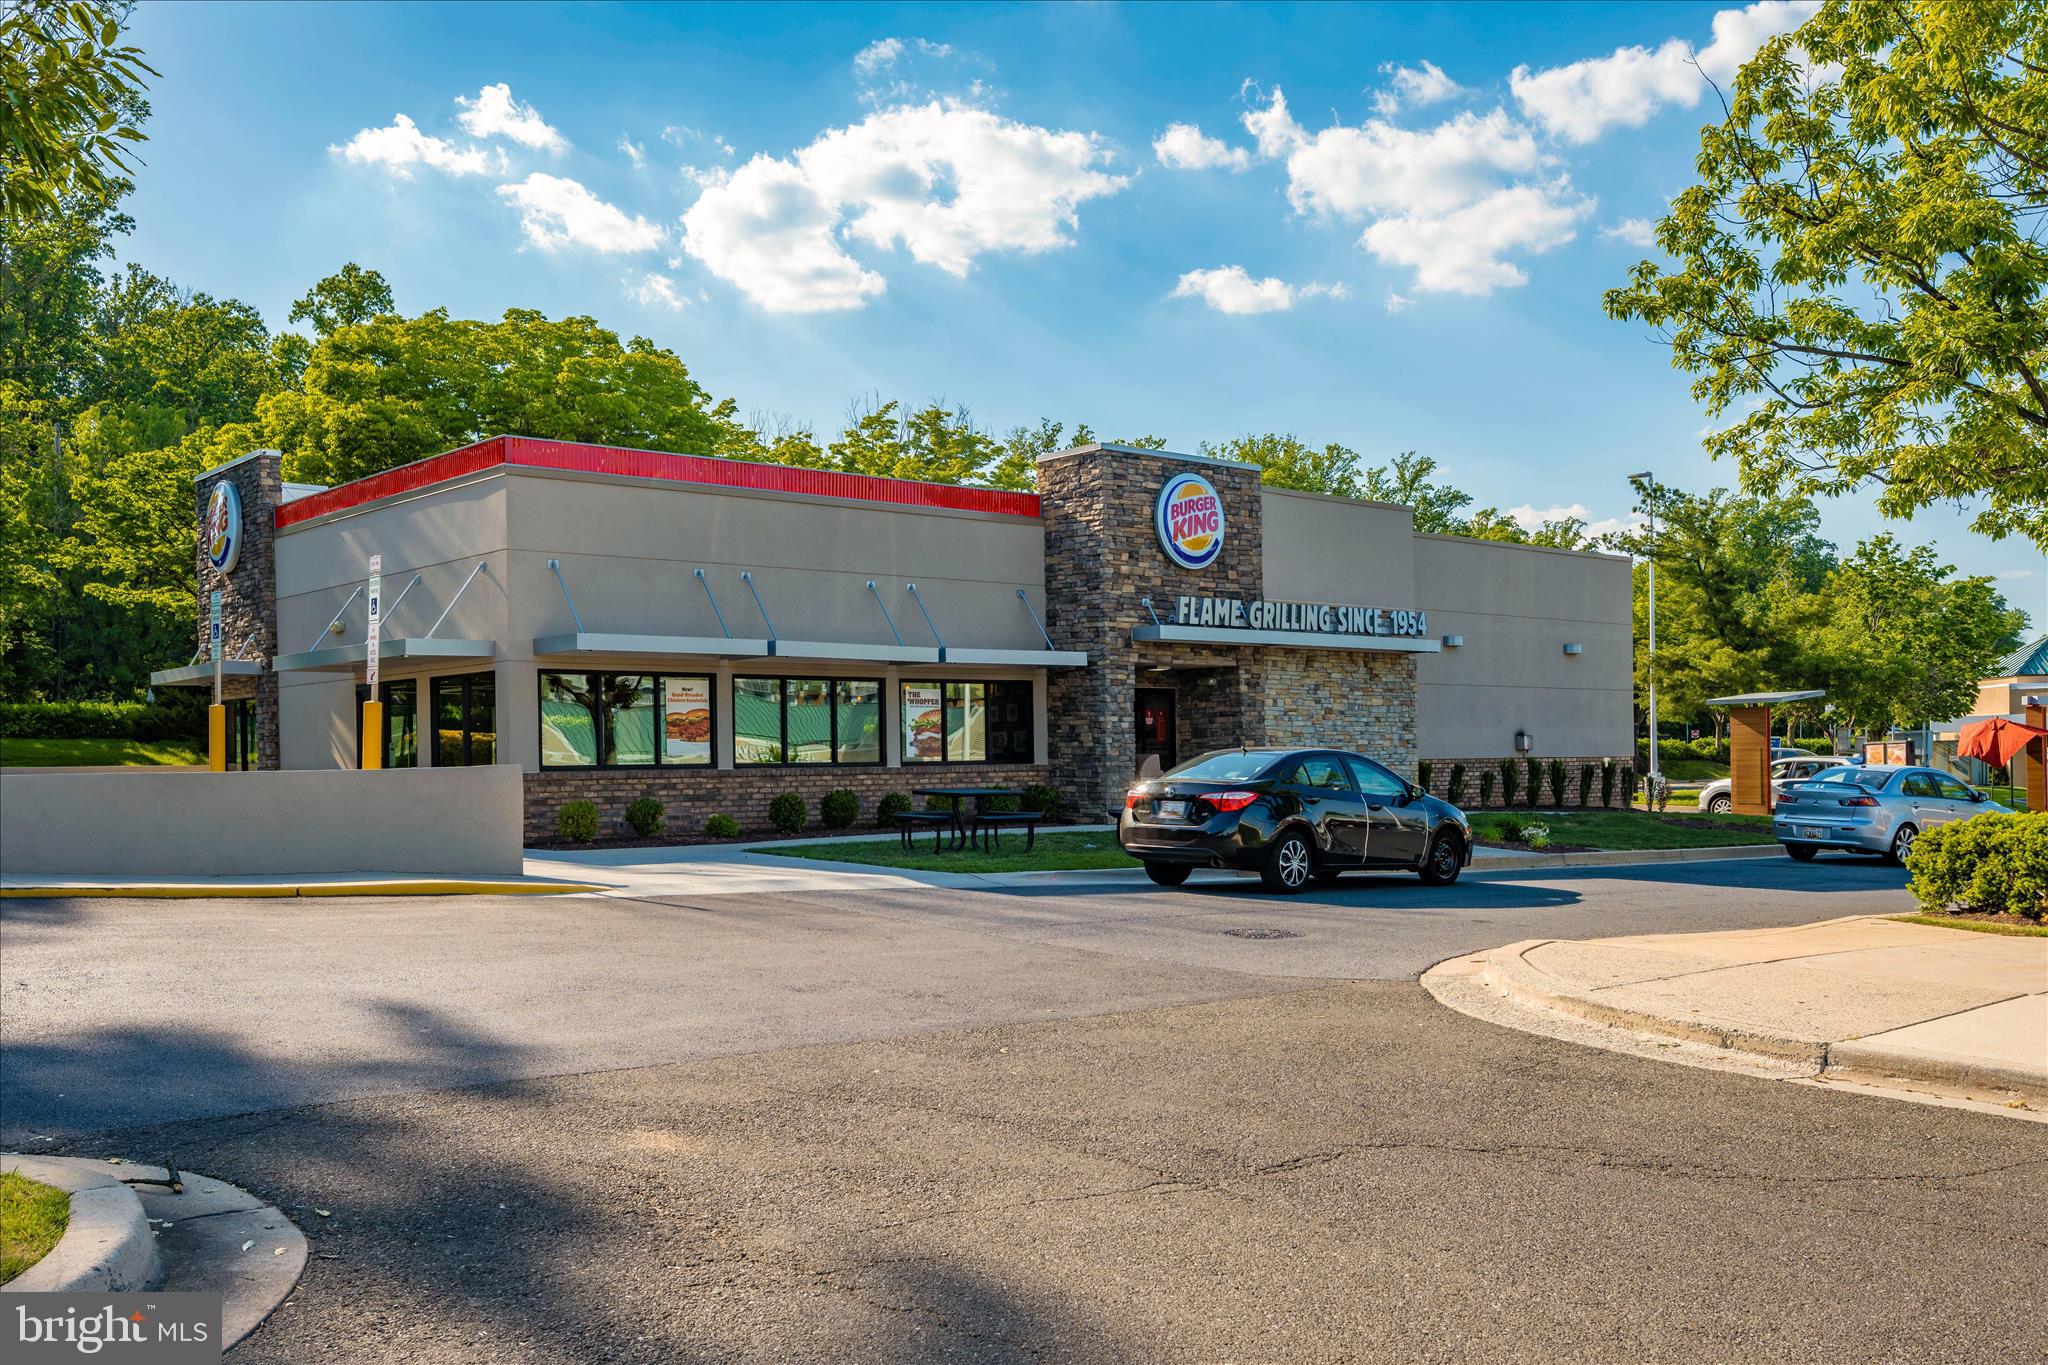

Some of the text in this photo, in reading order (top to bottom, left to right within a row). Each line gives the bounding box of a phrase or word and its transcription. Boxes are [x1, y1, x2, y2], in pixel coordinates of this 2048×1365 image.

[1171, 496, 1216, 520] BURGER
[1173, 511, 1219, 542] KING
[1178, 596, 1428, 635] FLAME GRILLING SINCE 1954
